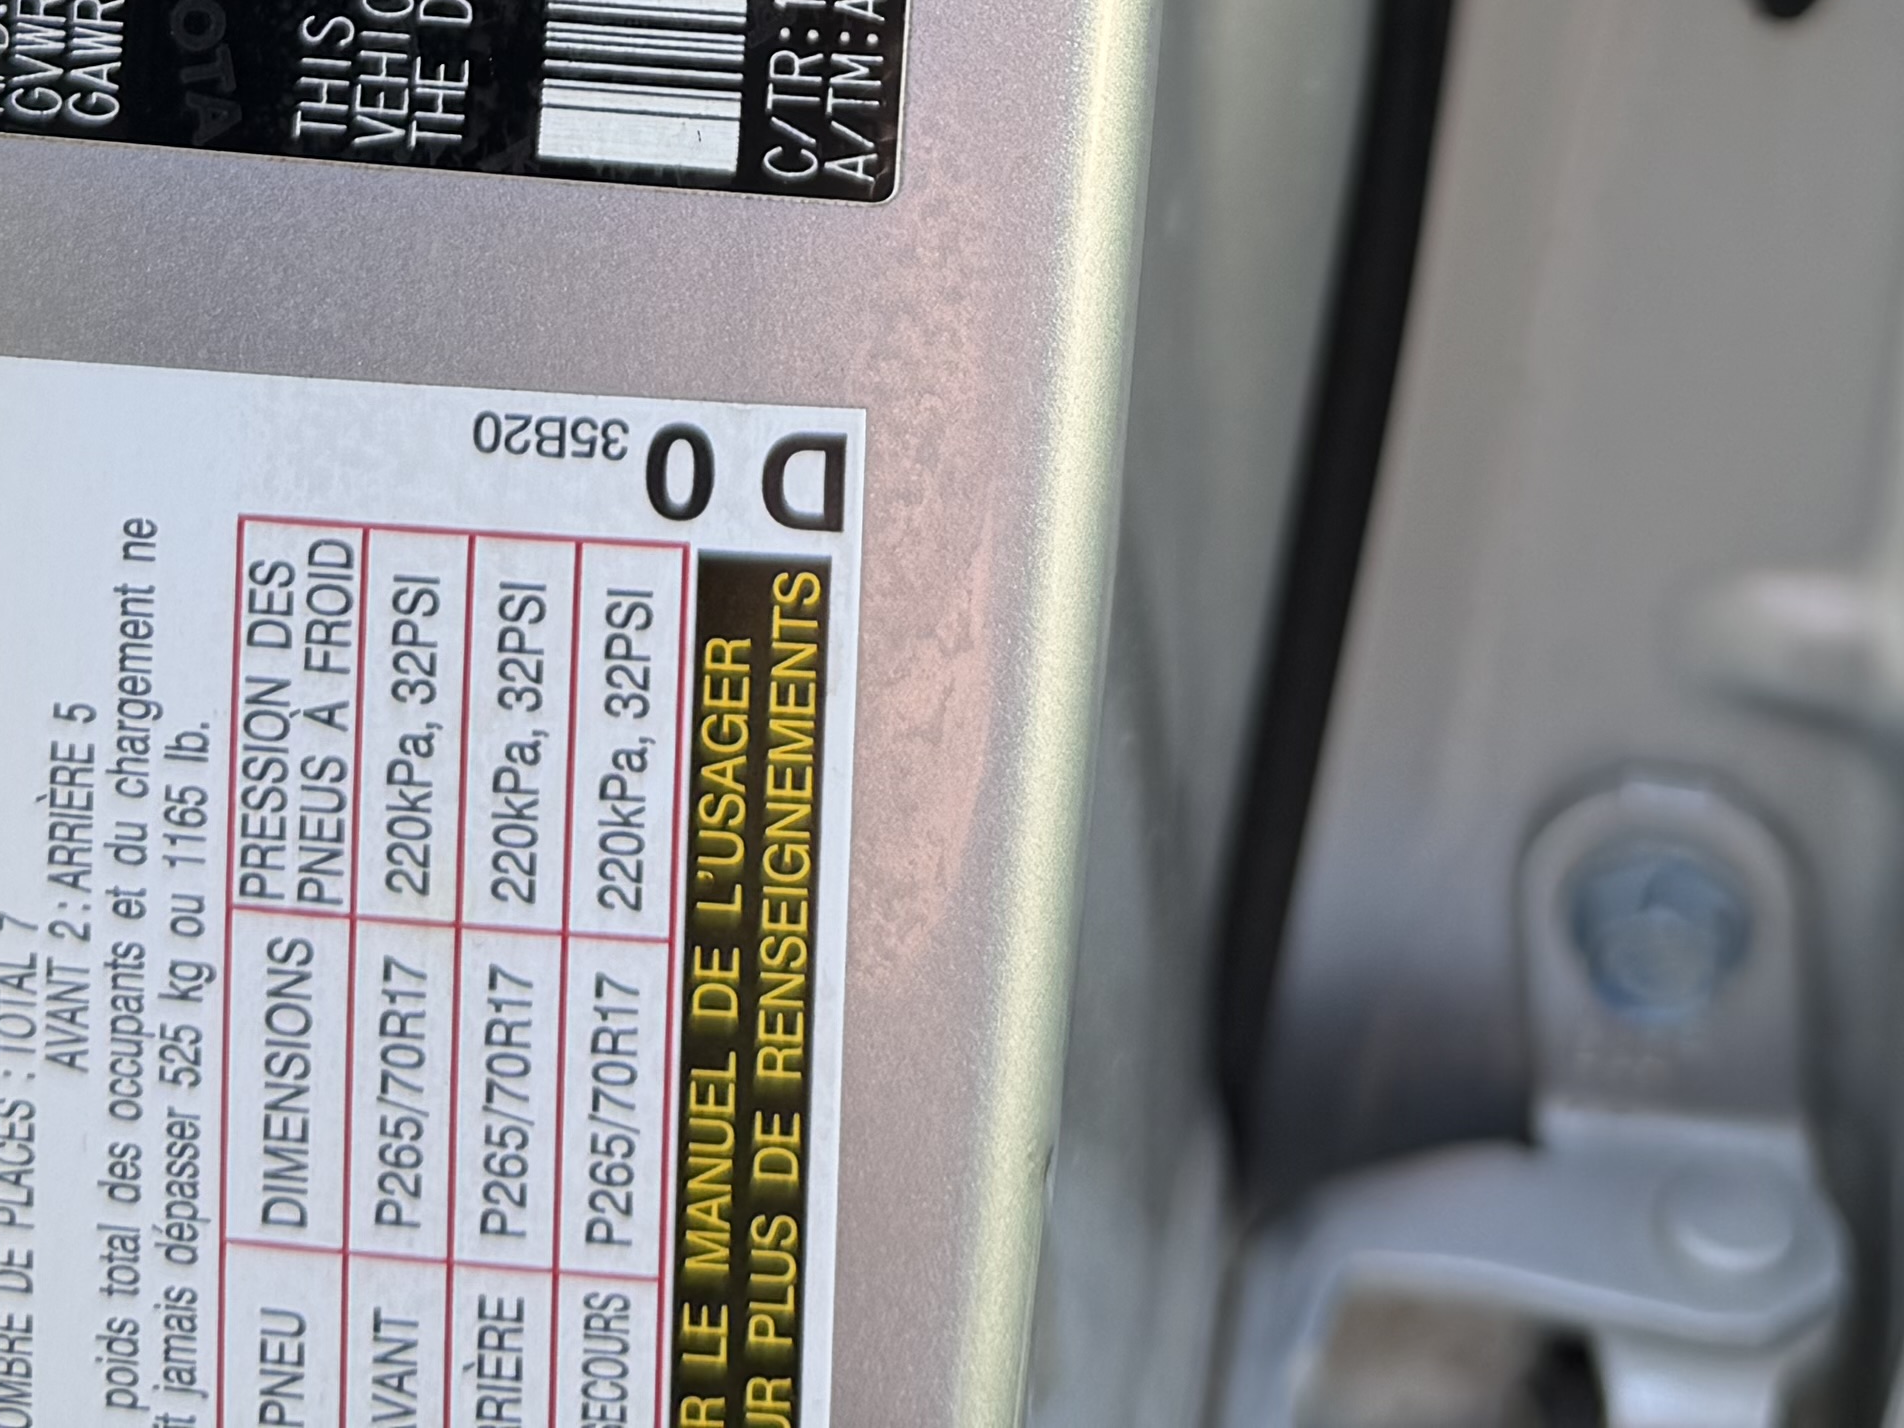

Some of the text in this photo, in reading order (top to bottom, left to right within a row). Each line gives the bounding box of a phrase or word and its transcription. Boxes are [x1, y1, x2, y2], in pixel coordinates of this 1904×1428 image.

[293, 15, 355, 137] THIS
[409, 56, 470, 148] THE
[470, 409, 631, 462] 35B20
[760, 429, 849, 534] D
[52, 701, 98, 724] 5
[164, 721, 211, 764] lb.
[239, 558, 297, 901] PRESSION DES
[288, 537, 356, 906] PNEUS À FROID
[383, 572, 444, 897] 220kPa, 32PSI
[489, 580, 551, 905] 220kPa, 32PSI
[595, 587, 656, 913] 220kPa, 32PSI
[696, 635, 754, 915] L'USAGER
[35, 739, 96, 894] ARRIÈRE
[163, 784, 208, 868] 1165
[755, 570, 822, 1080] RENSEIGNEMENTS
[94, 516, 163, 1412] poids total des occupants et du chargement ne
[170, 893, 206, 938] ou
[44, 956, 92, 1074] AVANT
[158, 958, 217, 1004] kg
[692, 944, 742, 1021] DE
[158, 1023, 203, 1089] 525
[260, 935, 315, 1230] DIMENSIONS
[372, 954, 431, 1230] P265/70R17
[478, 962, 536, 1240] P265/70R17
[584, 971, 642, 1248] P265/70R17
[151, 1106, 211, 1266] dépasser
[683, 1050, 738, 1273] MANUEL
[753, 1110, 802, 1183] DE
[152, 1284, 209, 1401] jamais
[681, 1301, 729, 1367] LE
[747, 1213, 798, 1346] PLUS
[258, 1306, 308, 1428] PNEU
[370, 1306, 420, 1428] VANT
[461, 1293, 525, 1428] RIÈRE
